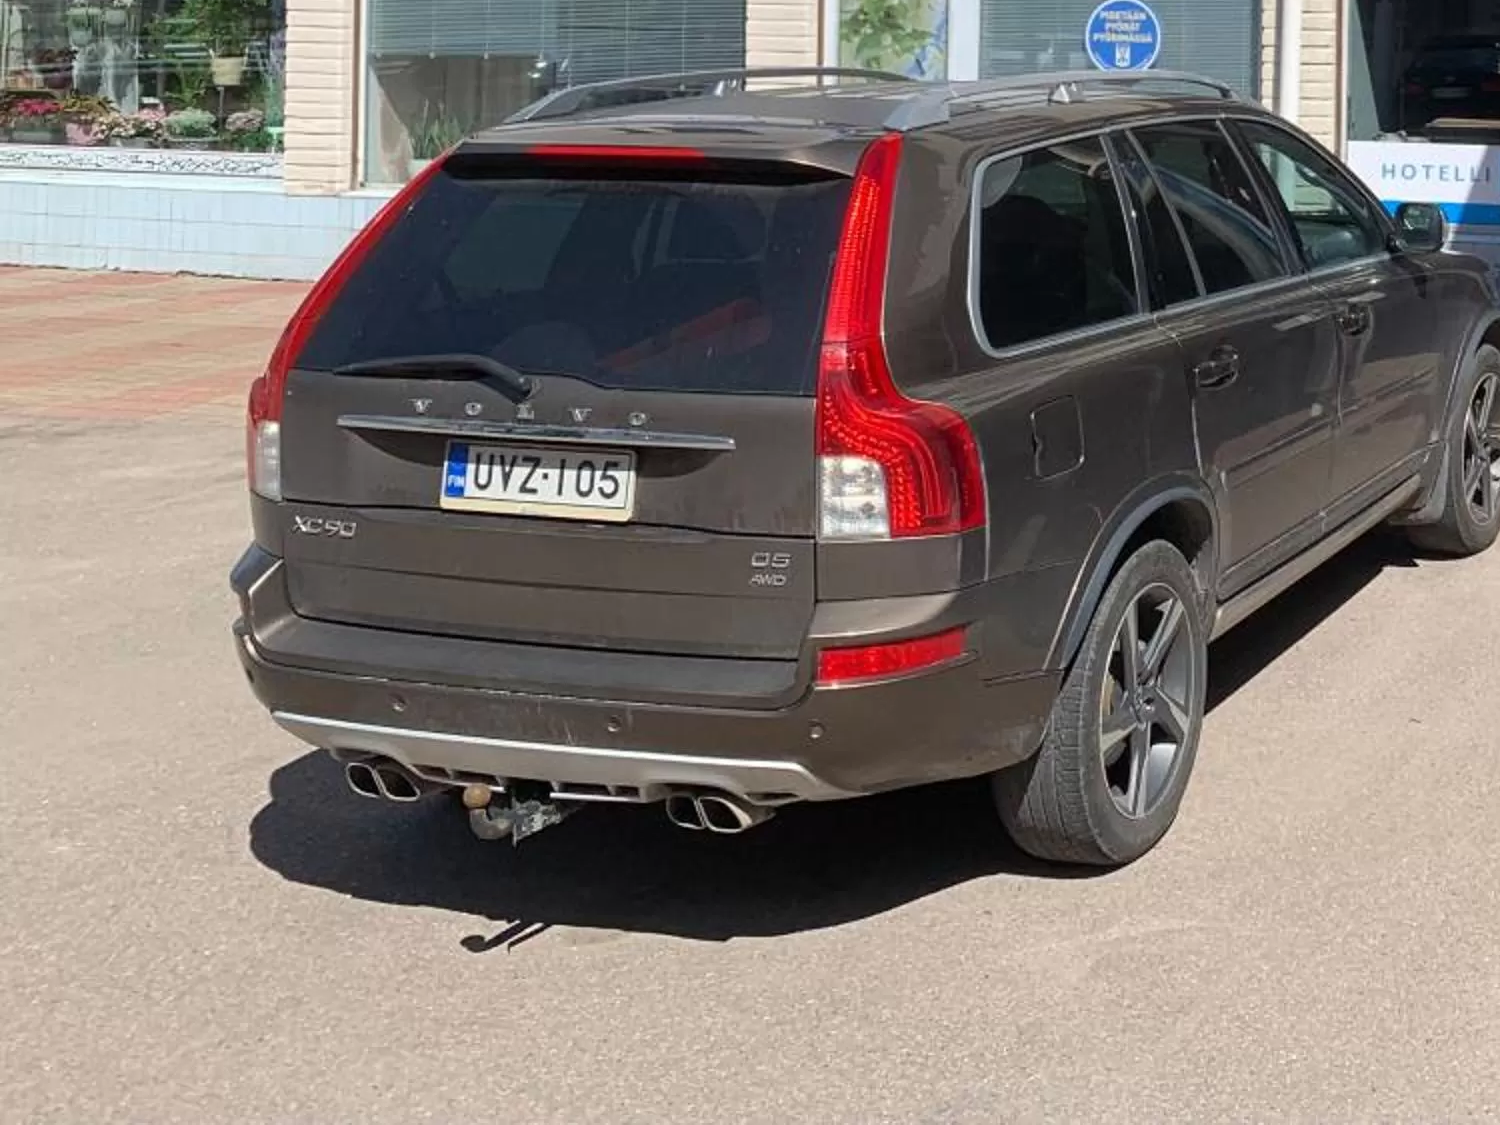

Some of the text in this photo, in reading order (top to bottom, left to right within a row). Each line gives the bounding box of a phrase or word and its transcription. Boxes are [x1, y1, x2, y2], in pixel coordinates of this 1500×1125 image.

[1381, 163, 1491, 183] HOTELLI
[409, 397, 647, 426] VOLVO
[292, 515, 357, 539] XC90
[750, 574, 787, 586] AWD
